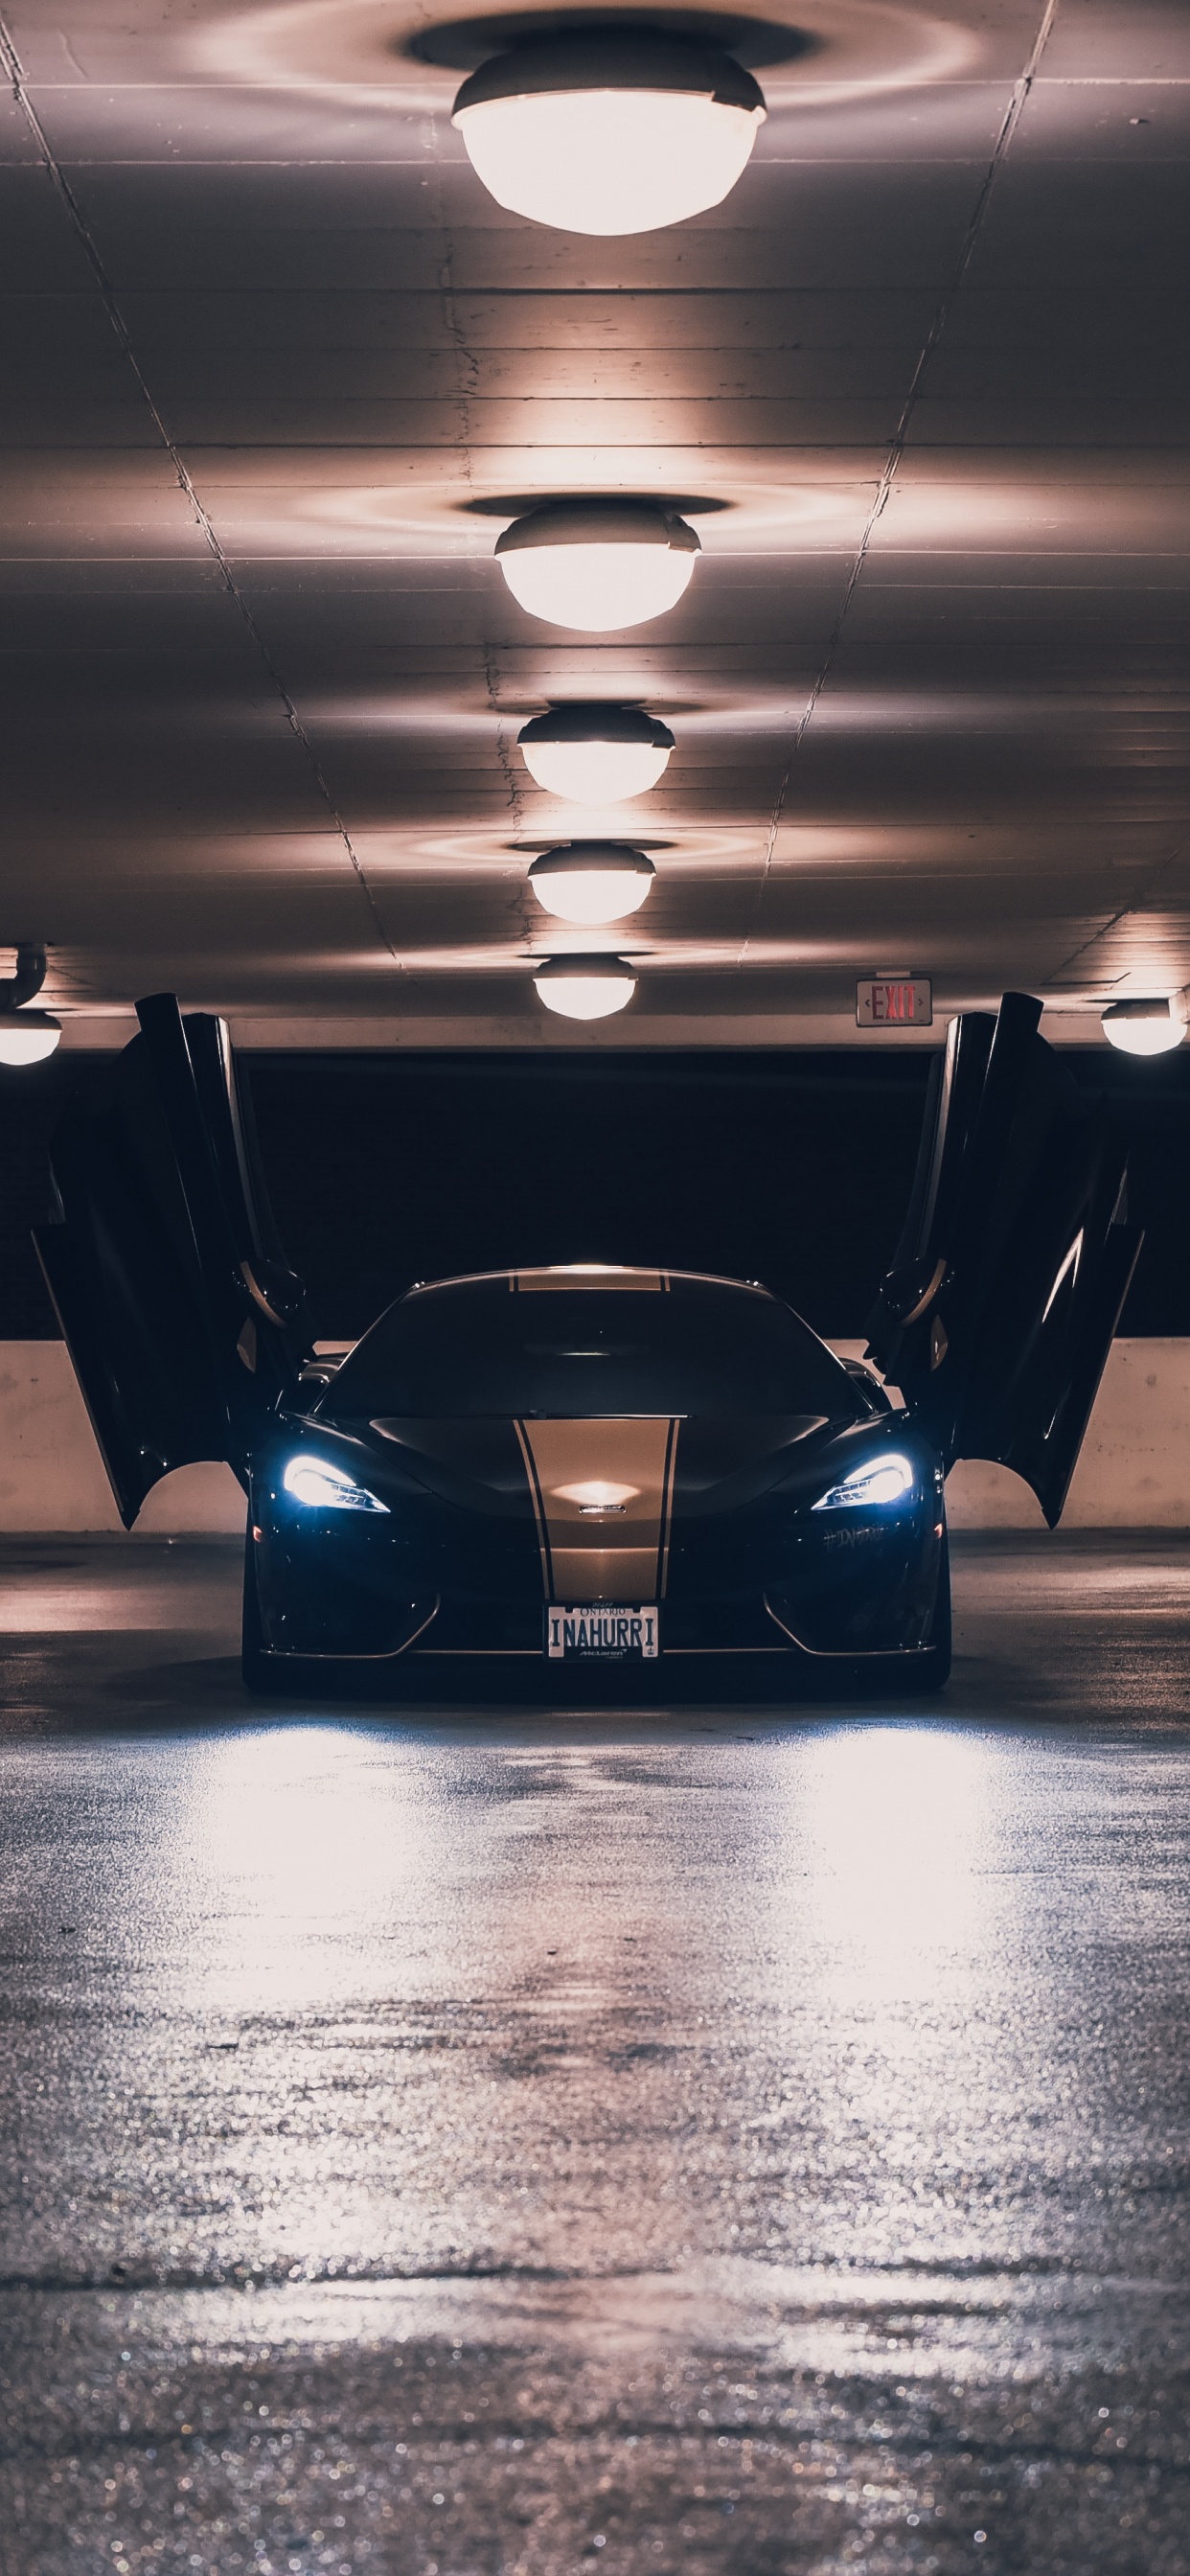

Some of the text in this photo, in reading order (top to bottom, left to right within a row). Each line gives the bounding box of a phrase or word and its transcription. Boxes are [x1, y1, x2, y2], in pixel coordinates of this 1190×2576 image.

[872, 985, 916, 1020] EXIT
[580, 1608, 626, 1617] ONTARIO
[552, 1618, 653, 1646] INAHURRI
